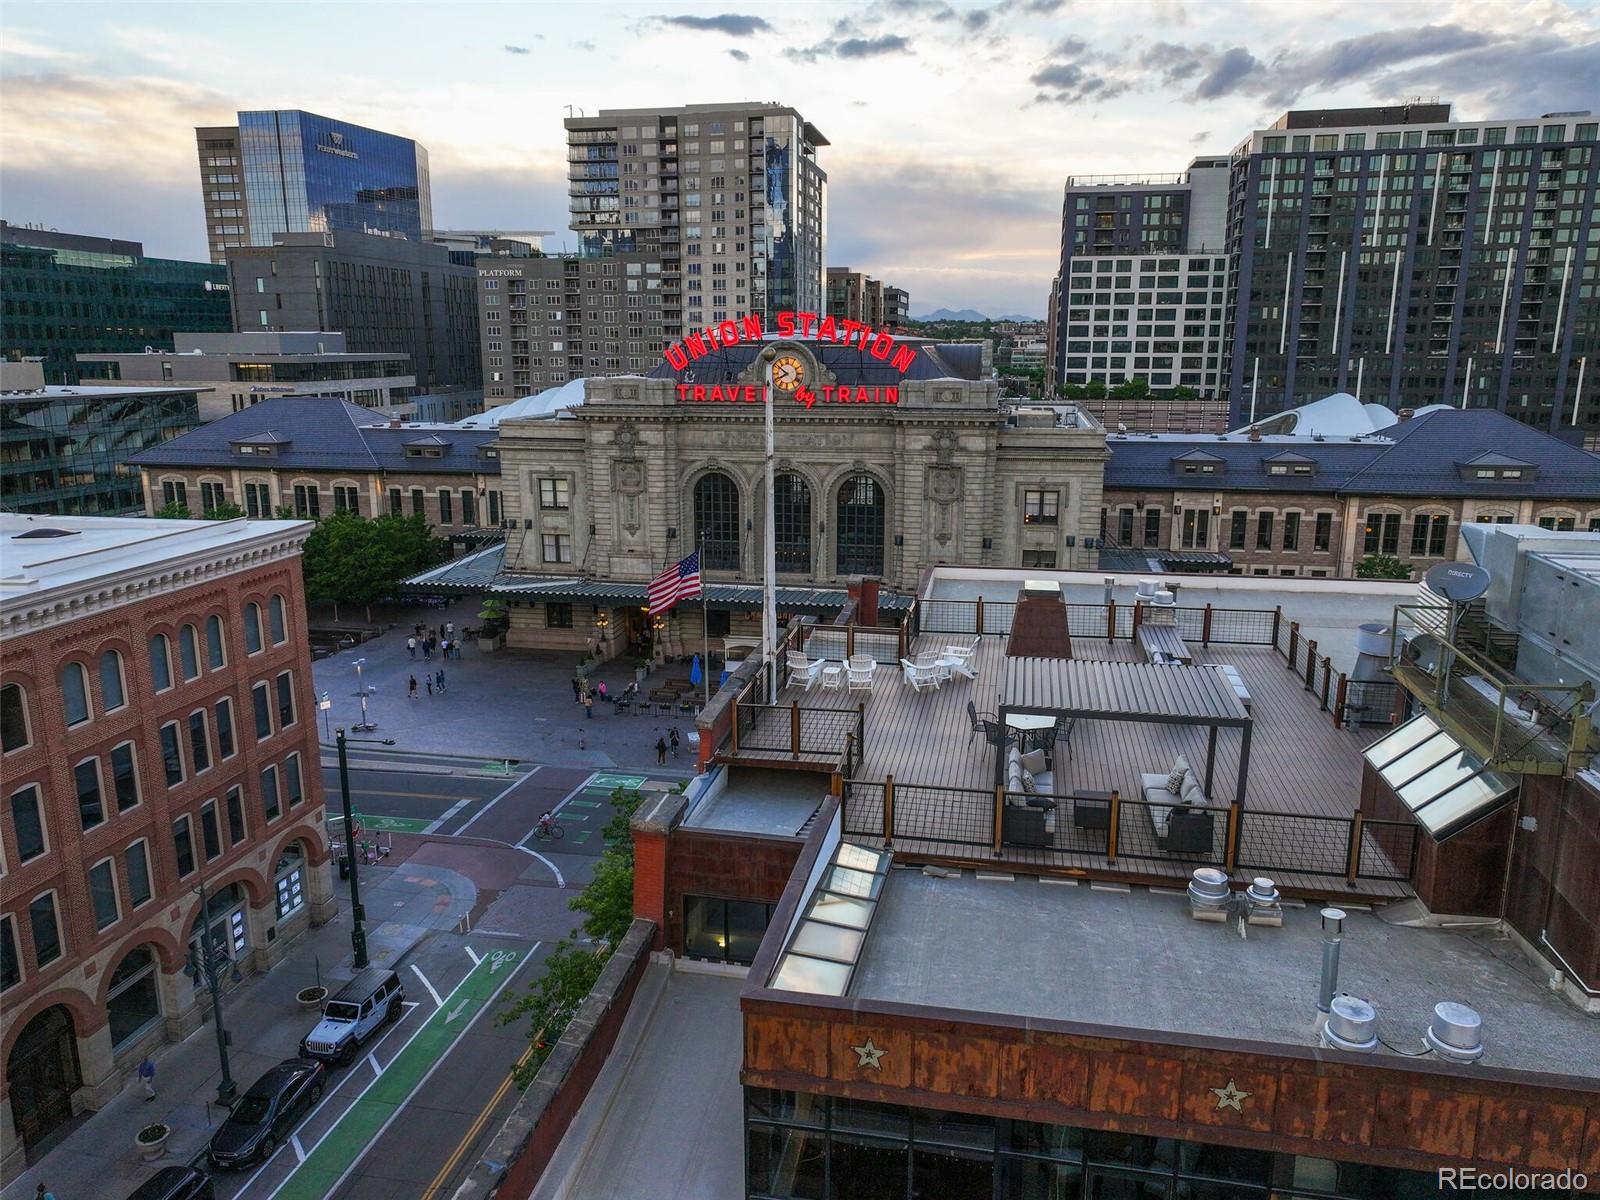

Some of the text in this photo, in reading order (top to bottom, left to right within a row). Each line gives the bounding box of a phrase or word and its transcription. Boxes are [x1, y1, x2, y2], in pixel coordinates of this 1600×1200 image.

[478, 269, 523, 277] PLATFORM
[663, 311, 917, 374] UNION STATION
[795, 384, 817, 410] by
[821, 384, 899, 404] TRAIN
[1448, 570, 1473, 579] DIRECTV
